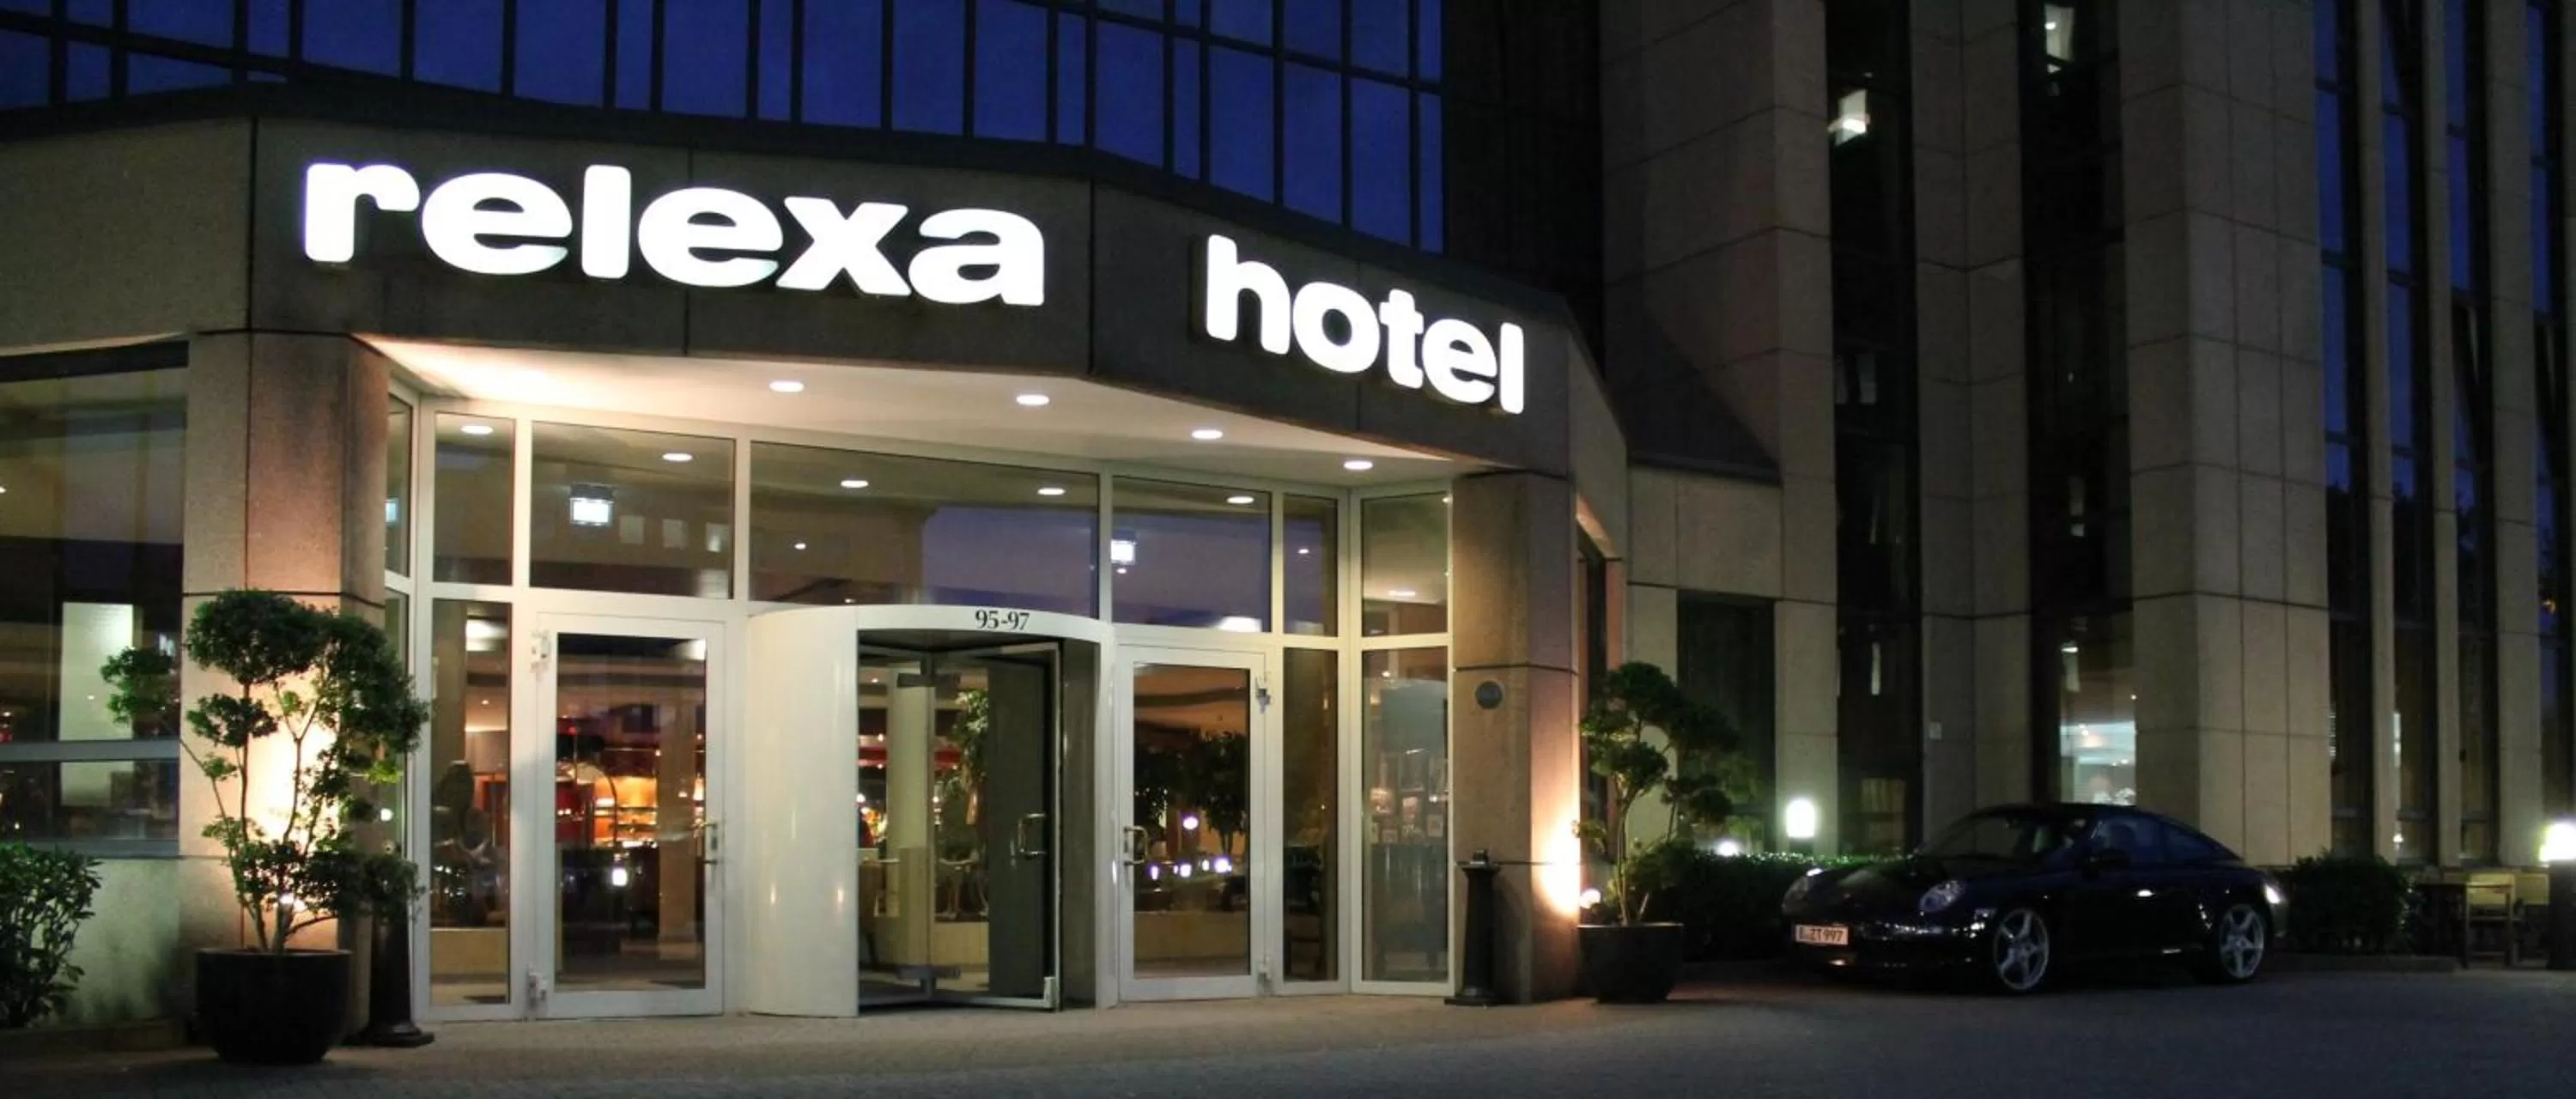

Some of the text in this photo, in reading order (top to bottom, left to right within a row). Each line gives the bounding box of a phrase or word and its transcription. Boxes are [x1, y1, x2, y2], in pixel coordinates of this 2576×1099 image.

[304, 162, 1526, 416] relexa hotel
[975, 609, 1030, 631] 95-97
